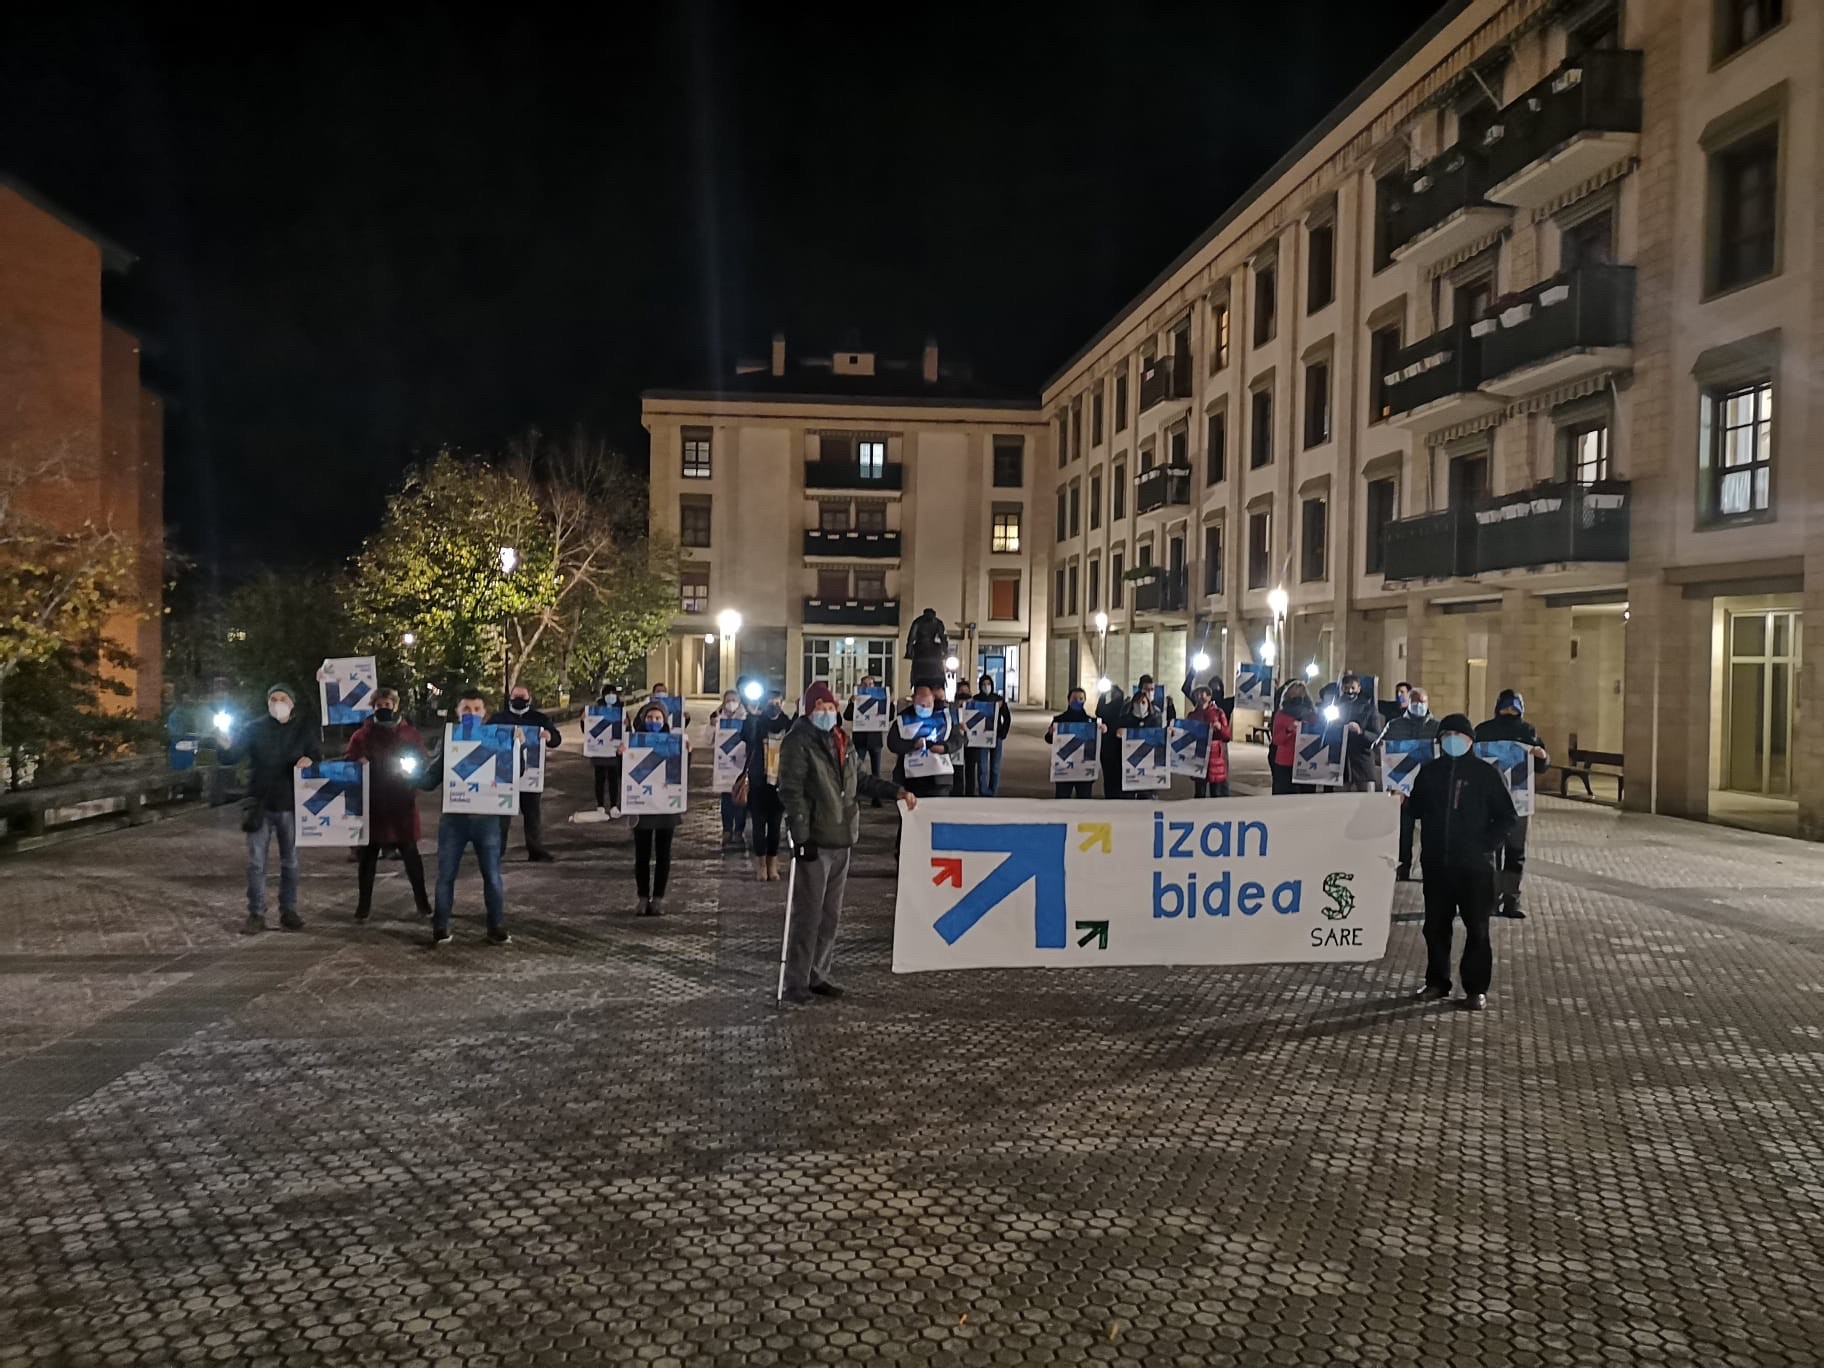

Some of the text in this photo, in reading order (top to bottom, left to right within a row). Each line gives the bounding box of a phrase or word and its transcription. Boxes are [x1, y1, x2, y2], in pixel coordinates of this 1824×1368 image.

[1153, 811, 1268, 858] izan
[1153, 871, 1302, 918] bidea
[1311, 928, 1363, 946] SARE
